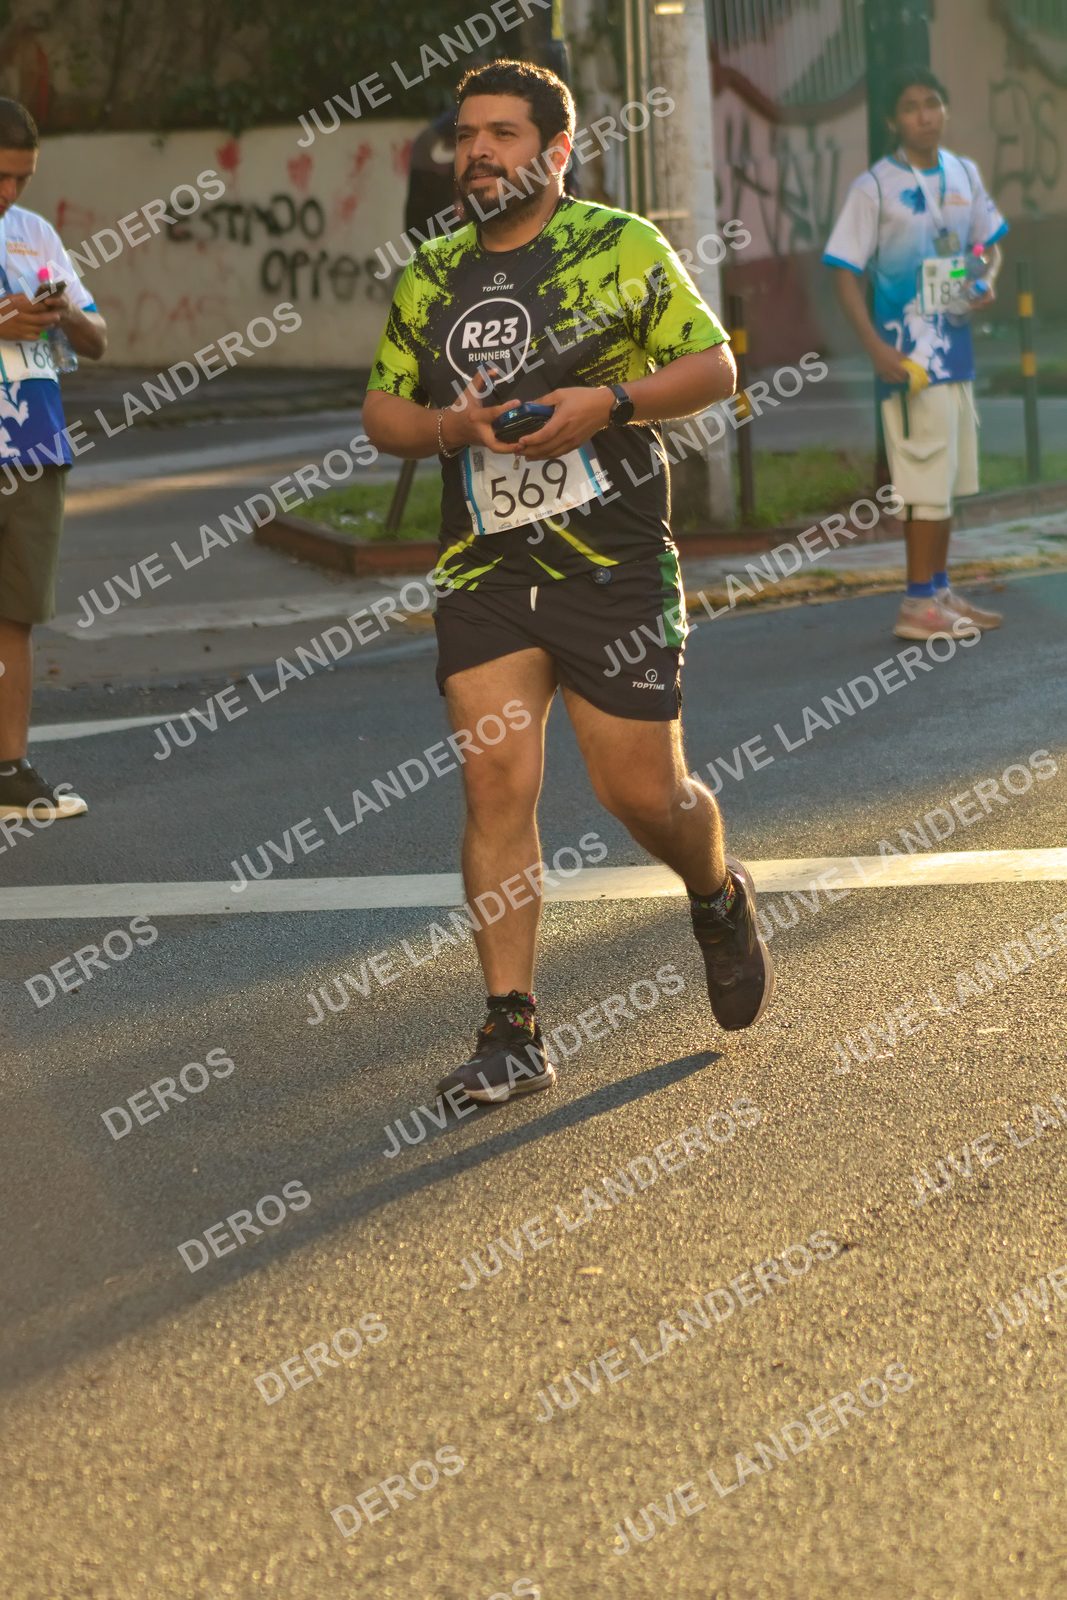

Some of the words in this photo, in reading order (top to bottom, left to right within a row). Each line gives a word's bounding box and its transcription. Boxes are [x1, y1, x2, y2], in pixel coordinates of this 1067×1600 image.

[482, 283, 515, 292] TOPTIME
[461, 316, 519, 349] R23
[468, 349, 511, 362] RUNNERS
[490, 459, 568, 518] 569
[632, 681, 665, 690] TOPTIME
